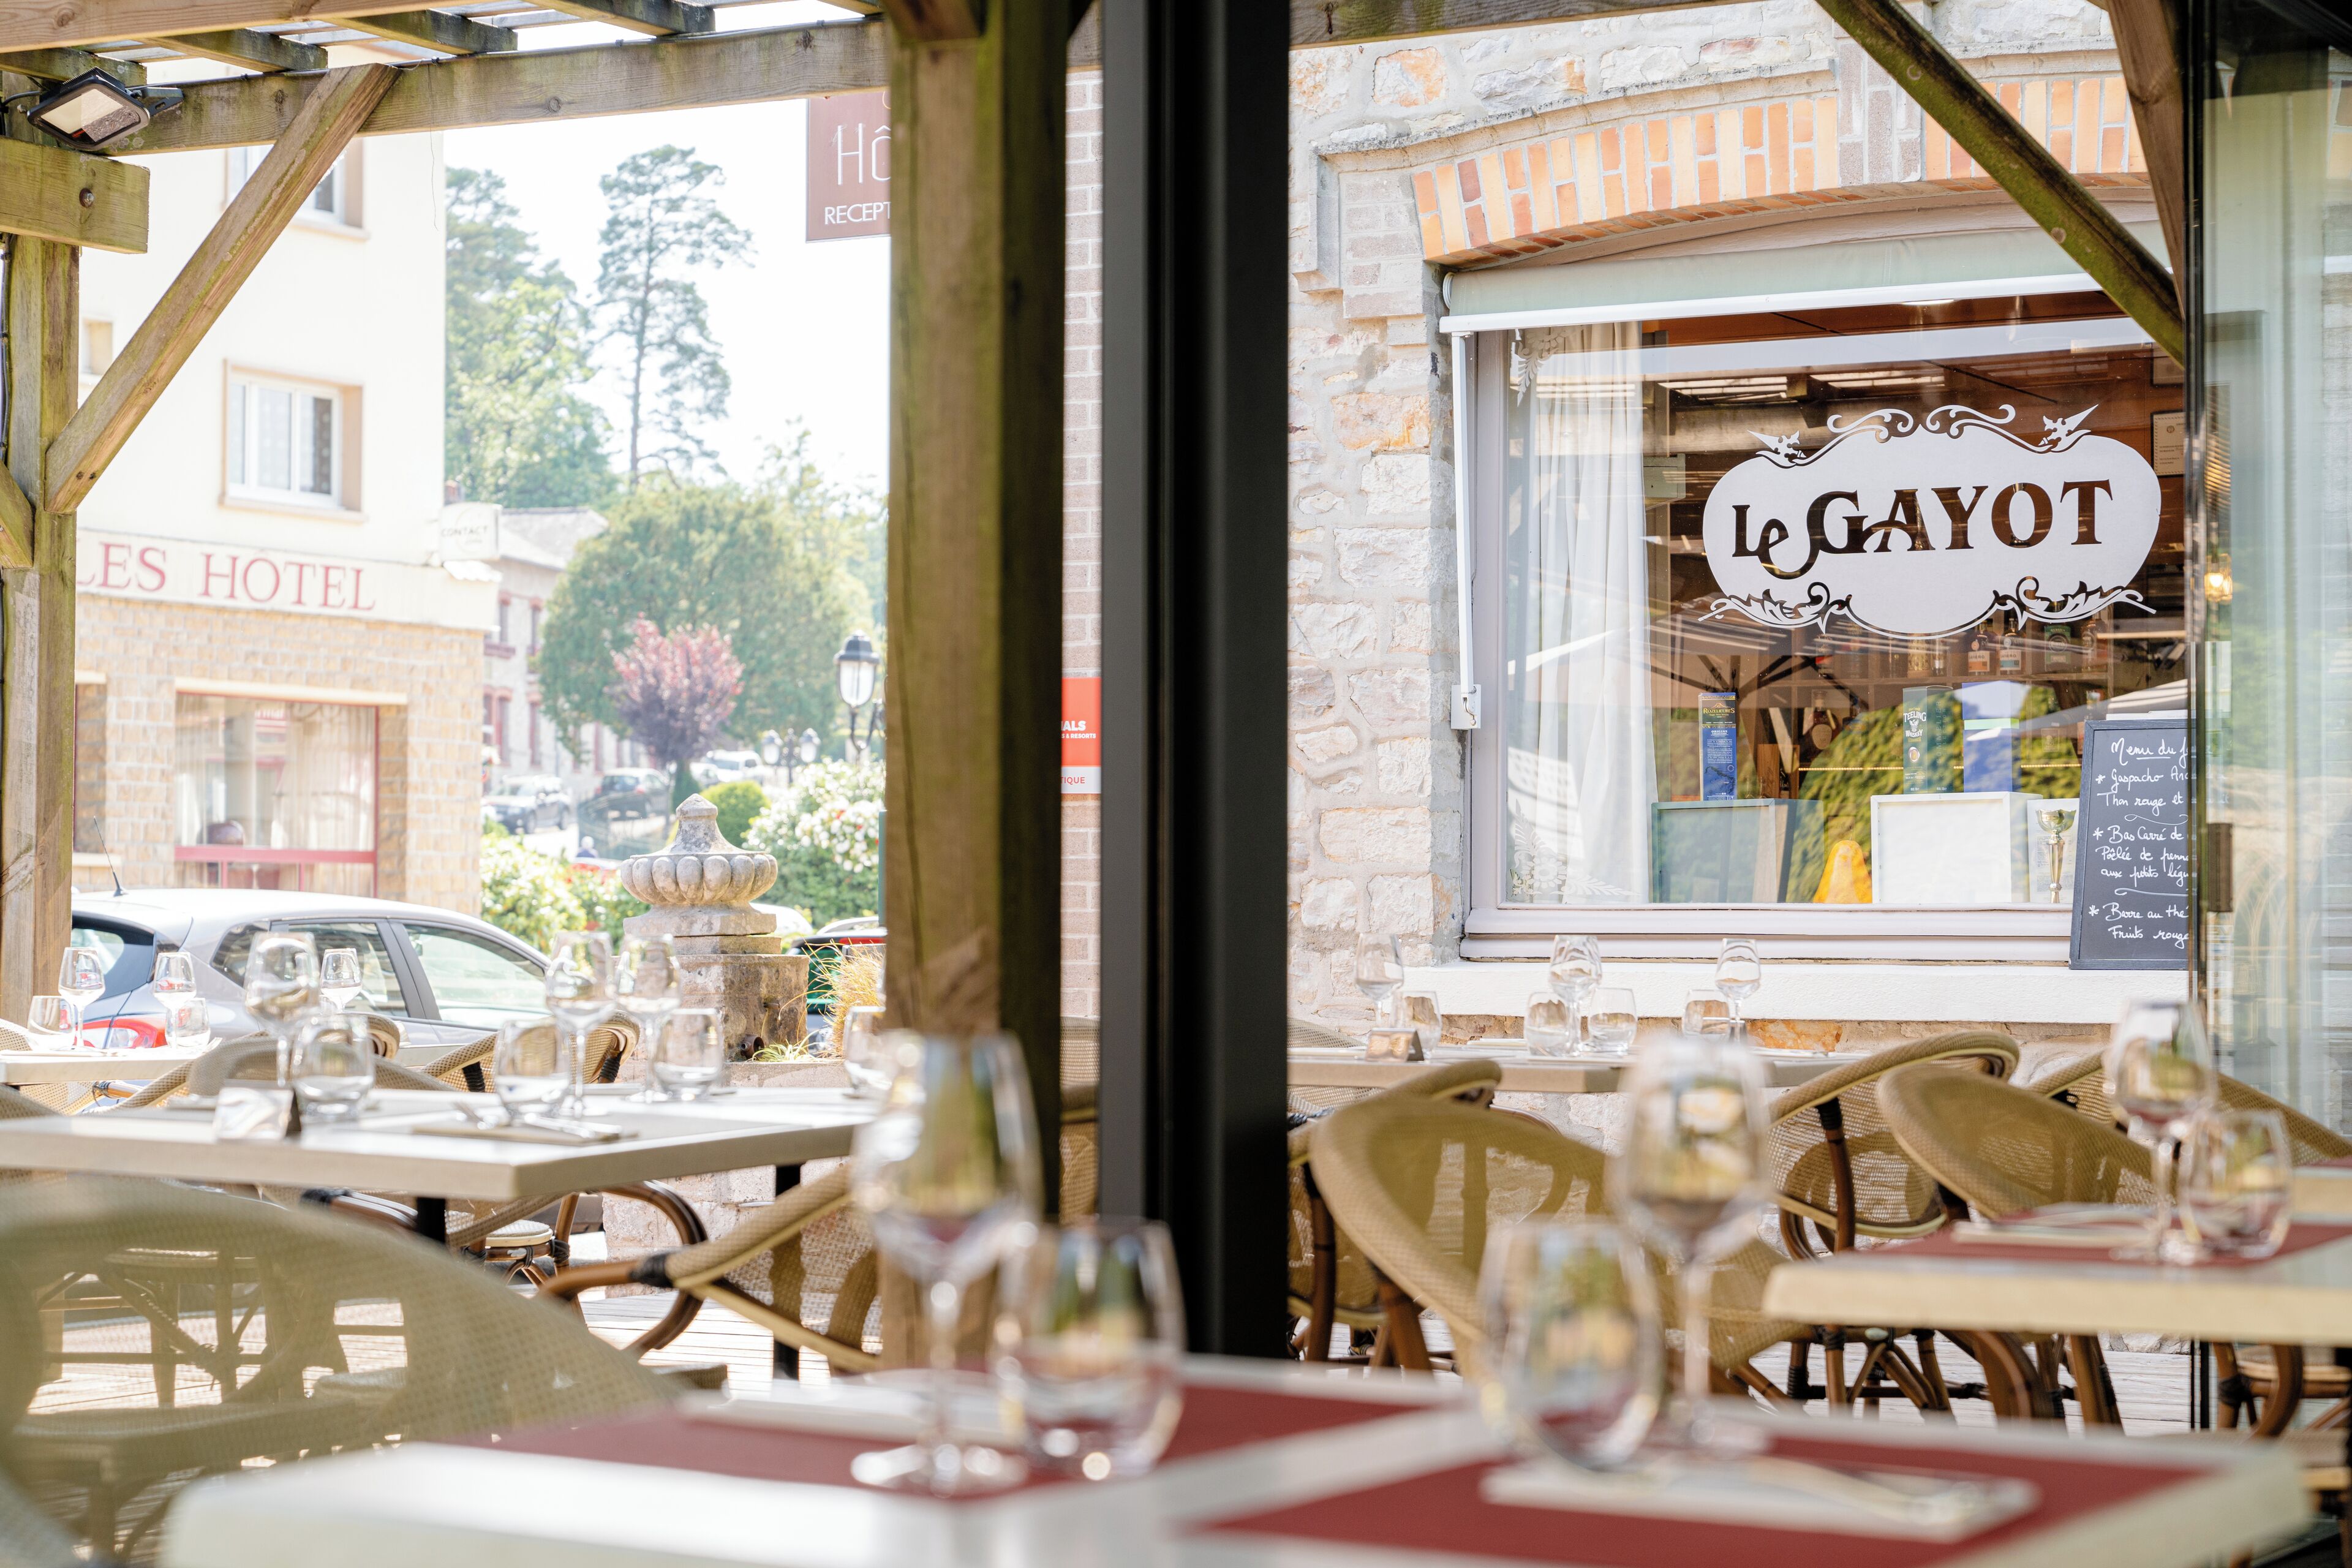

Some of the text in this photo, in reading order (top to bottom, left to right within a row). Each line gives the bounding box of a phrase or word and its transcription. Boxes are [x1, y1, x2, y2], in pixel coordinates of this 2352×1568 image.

[1806, 479, 2113, 554] GAYOT
[1903, 710, 1927, 723] TEELING
[1905, 729, 1923, 738] WHISKEY
[2111, 737, 2154, 766] Menu
[2158, 738, 2177, 755] du
[2111, 767, 2164, 793] Gaspacho
[2097, 791, 2184, 816] Thon rouge et
[2107, 824, 2185, 844] Bas Carré de
[2139, 846, 2154, 861] de
[2100, 868, 2123, 879] aux
[2129, 864, 2159, 888] petits
[2102, 902, 2144, 921] Barre
[2147, 910, 2164, 919] au
[2107, 924, 2144, 940] Fruits
